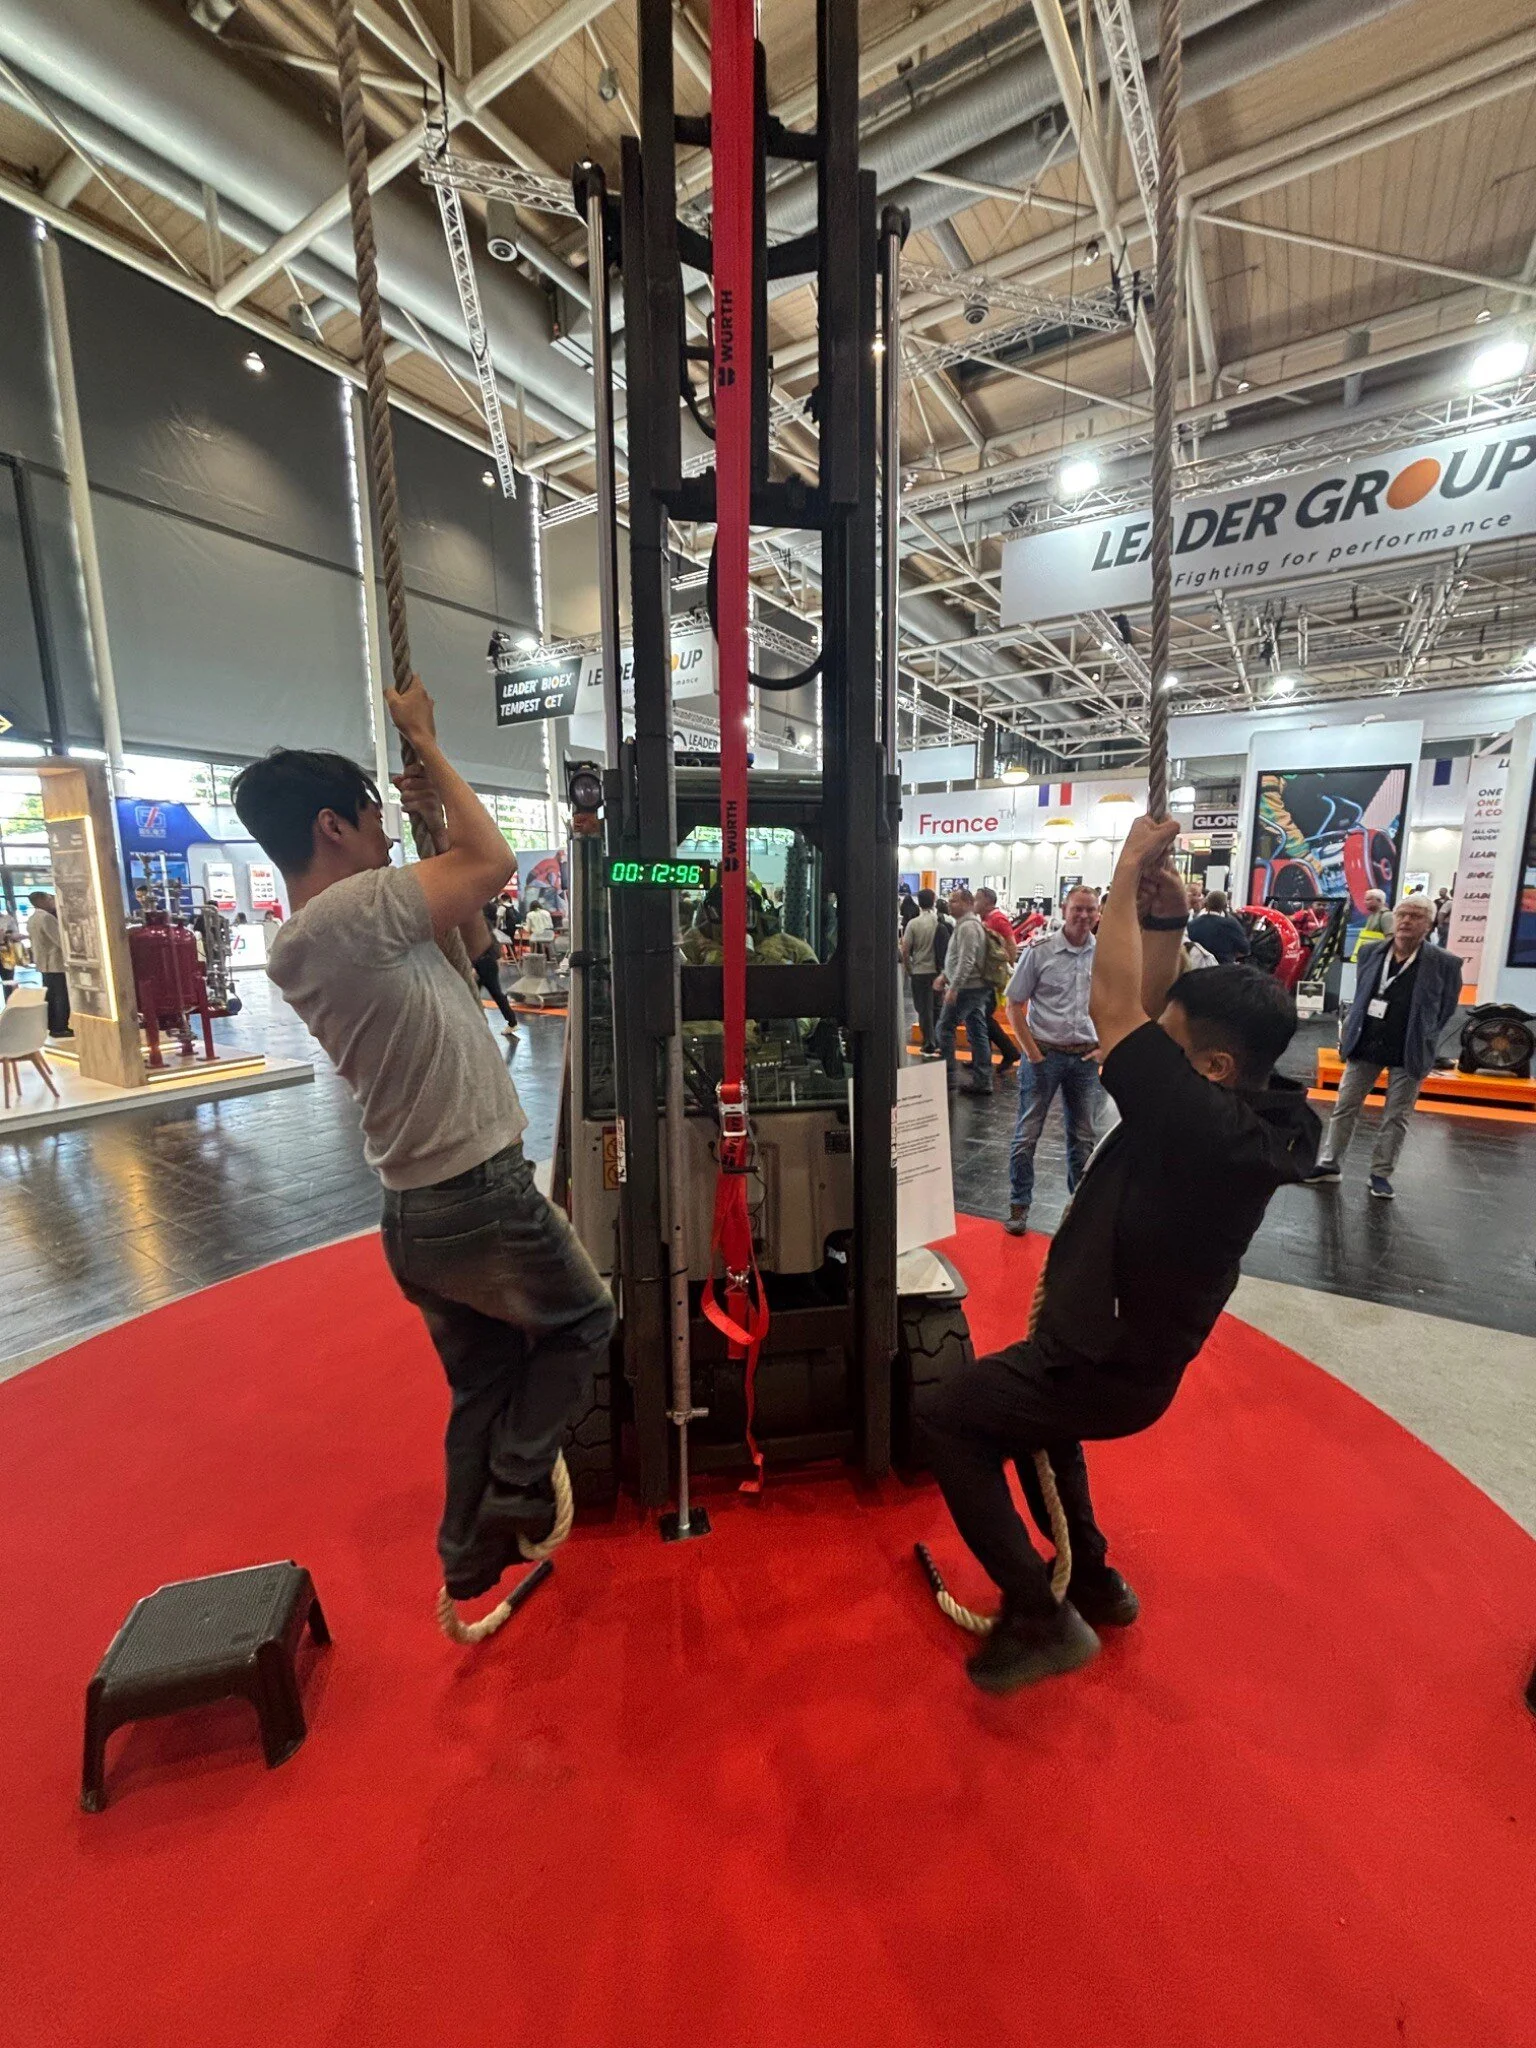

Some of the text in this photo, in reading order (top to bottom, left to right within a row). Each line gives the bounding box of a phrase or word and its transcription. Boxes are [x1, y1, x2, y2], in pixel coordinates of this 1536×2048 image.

[1295, 434, 1536, 530] GROUP
[1174, 512, 1512, 588] Fighting for performance
[502, 672, 573, 699] LEADER BIOEX
[587, 664, 635, 687] LEE
[500, 693, 564, 717] TEMPEST CET
[689, 733, 719, 751] LEADER
[1477, 799, 1501, 807] ONE
[1478, 788, 1503, 797] ONE
[919, 813, 999, 835] France
